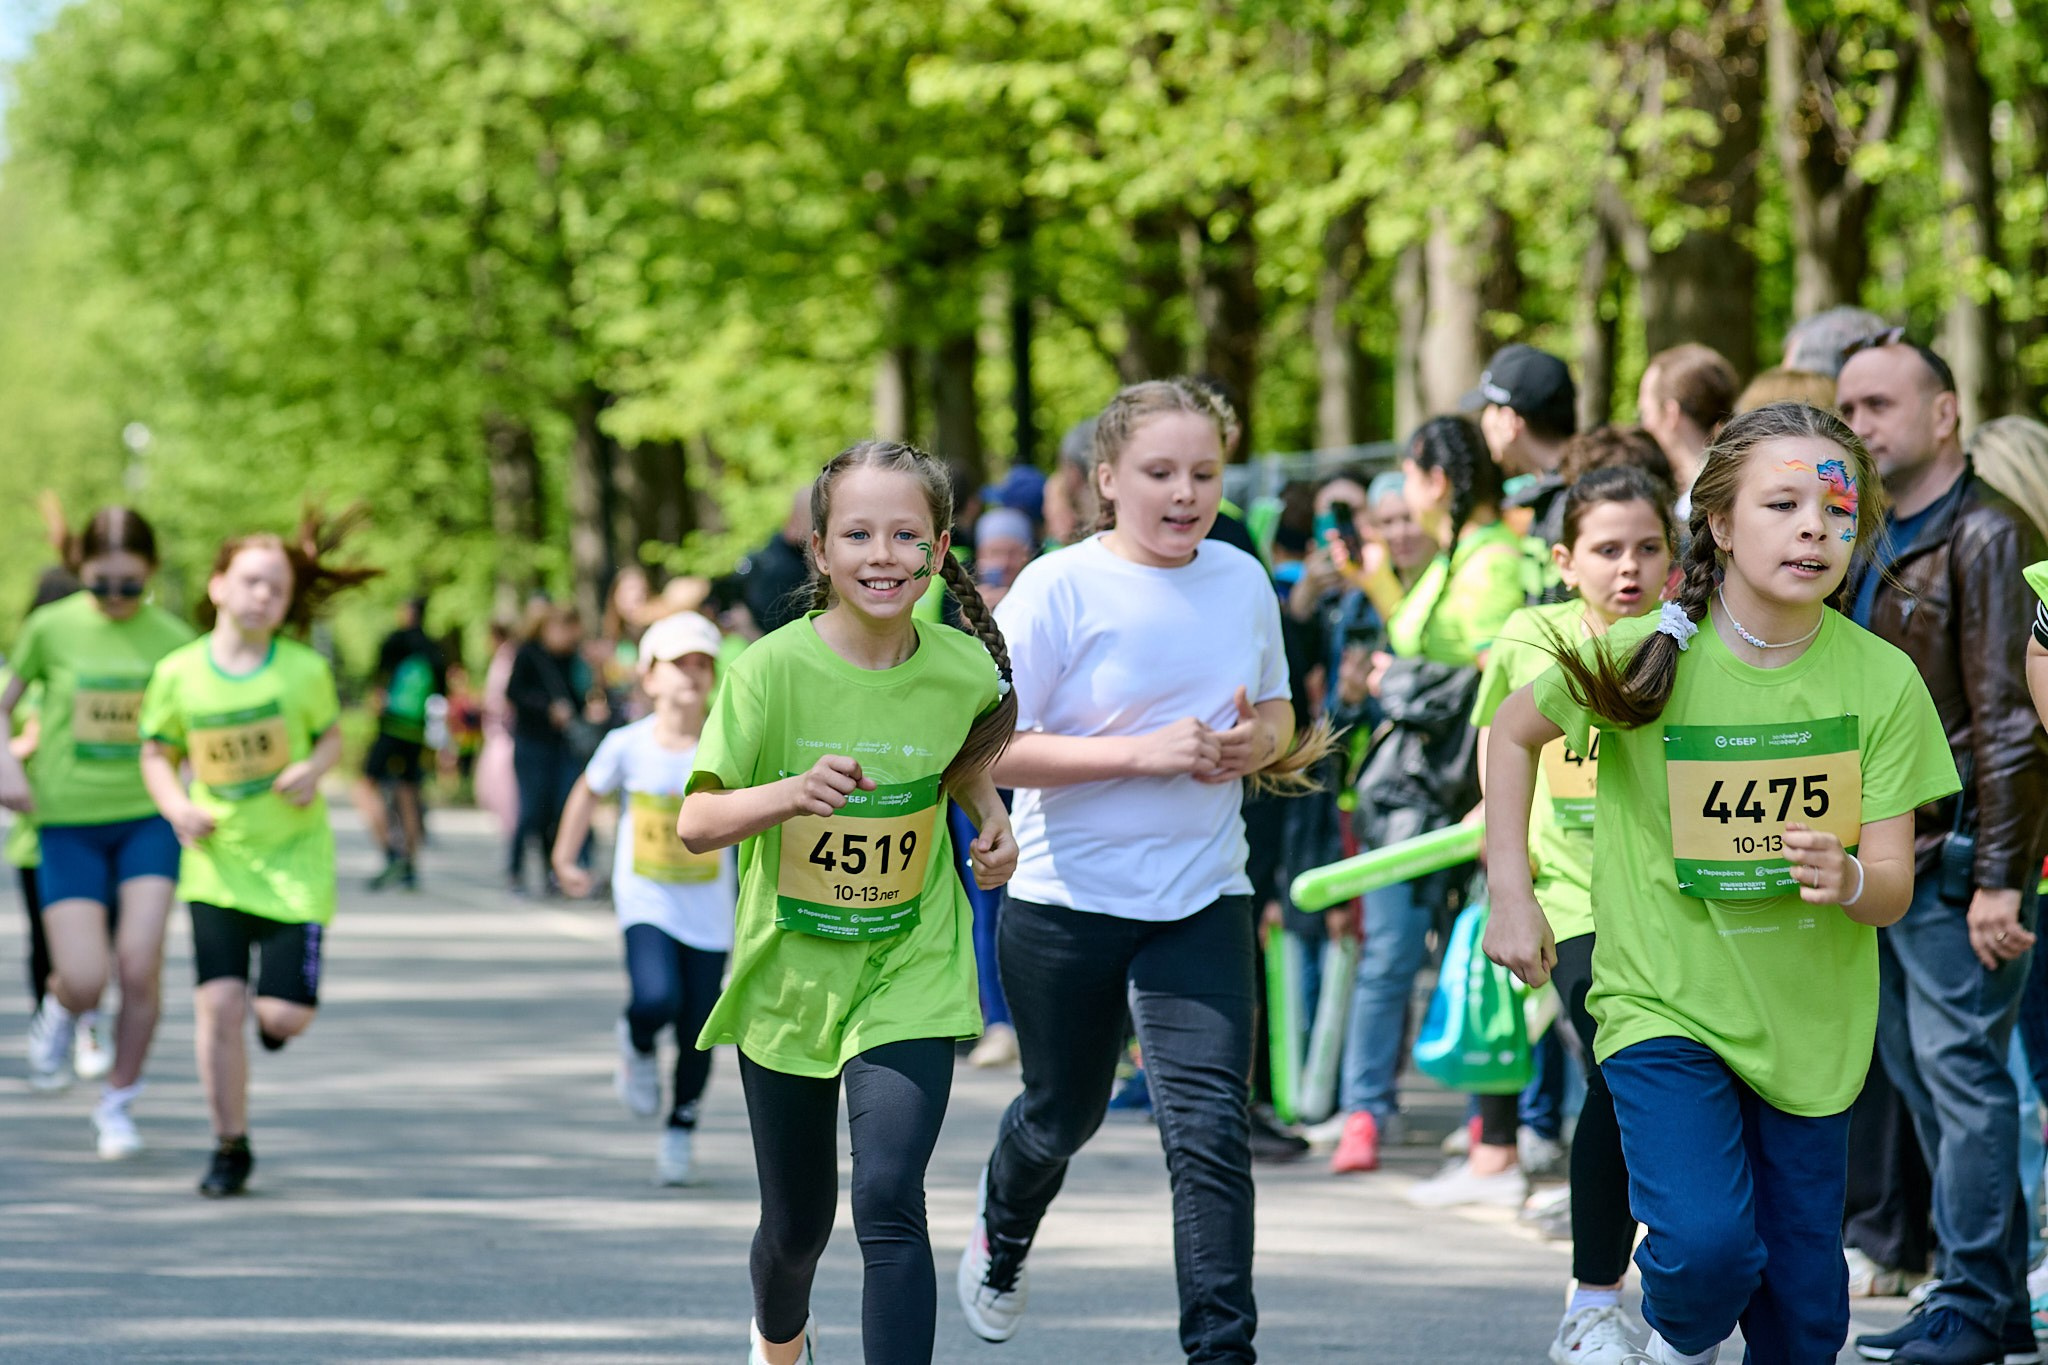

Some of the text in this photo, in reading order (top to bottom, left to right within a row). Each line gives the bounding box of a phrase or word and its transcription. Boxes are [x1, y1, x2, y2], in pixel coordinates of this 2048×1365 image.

[1729, 737, 1757, 746] СБЕР
[844, 794, 868, 804] БЕР
[1702, 774, 1830, 824] 4475
[1732, 834, 1783, 854] 10-13
[809, 830, 917, 875] 4519
[879, 889, 900, 901] лет
